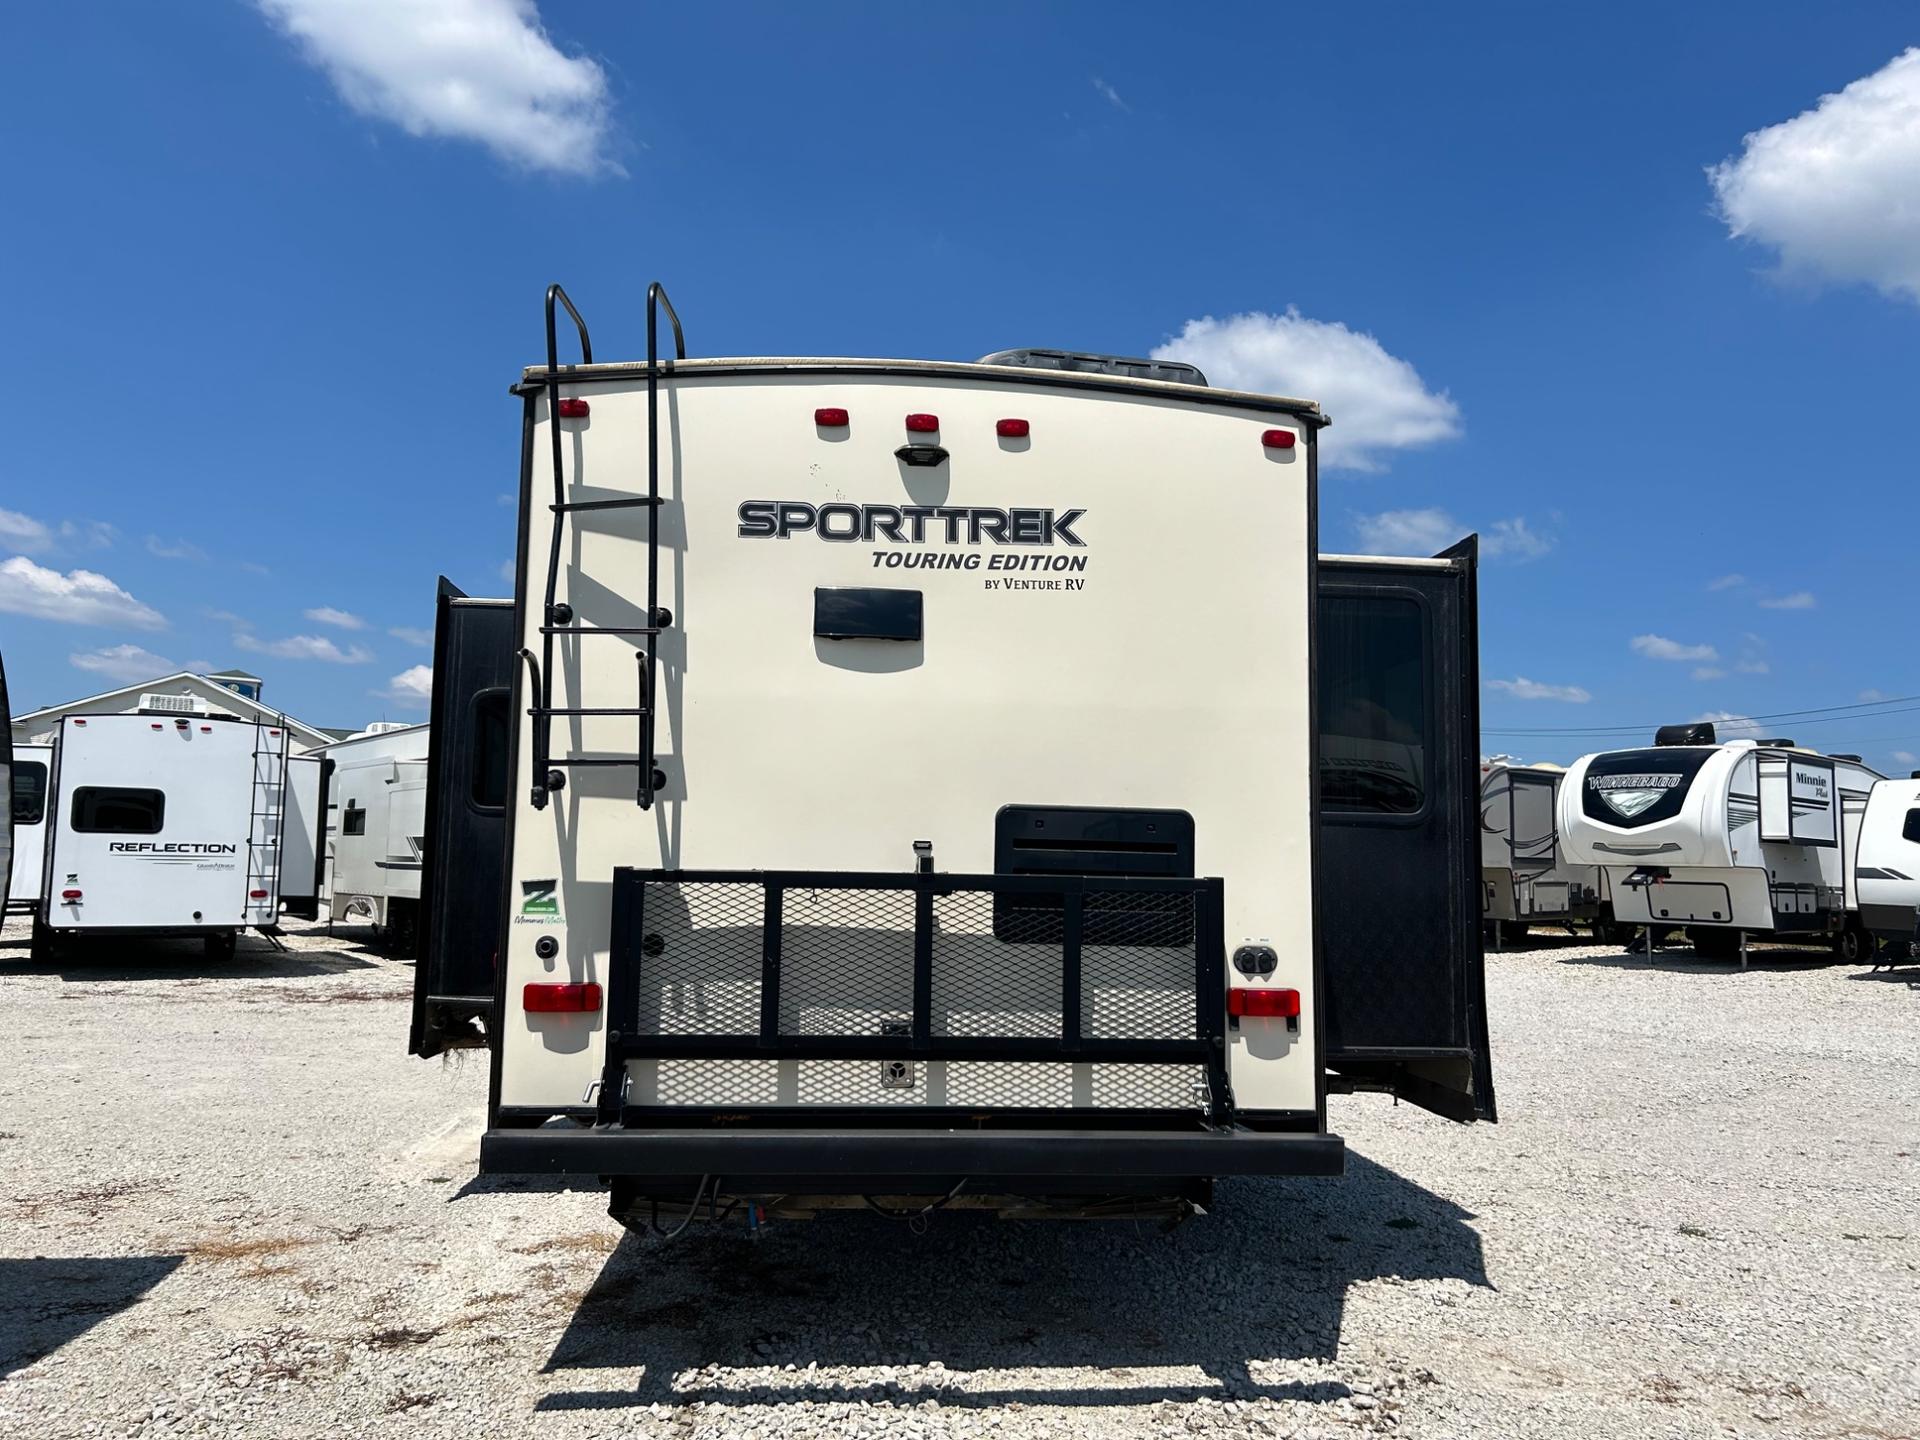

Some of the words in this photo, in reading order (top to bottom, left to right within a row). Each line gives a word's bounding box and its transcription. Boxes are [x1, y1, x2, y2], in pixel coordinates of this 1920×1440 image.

[737, 500, 1088, 547] SPORTTREK
[871, 551, 981, 570] TOURING
[987, 554, 1088, 572] EDITION
[984, 579, 1000, 590] BY
[1065, 578, 1086, 591] RV
[1588, 775, 1681, 790] WINNEBAGO
[1795, 772, 1827, 787] Minnie
[109, 842, 236, 853] REFLECTION
